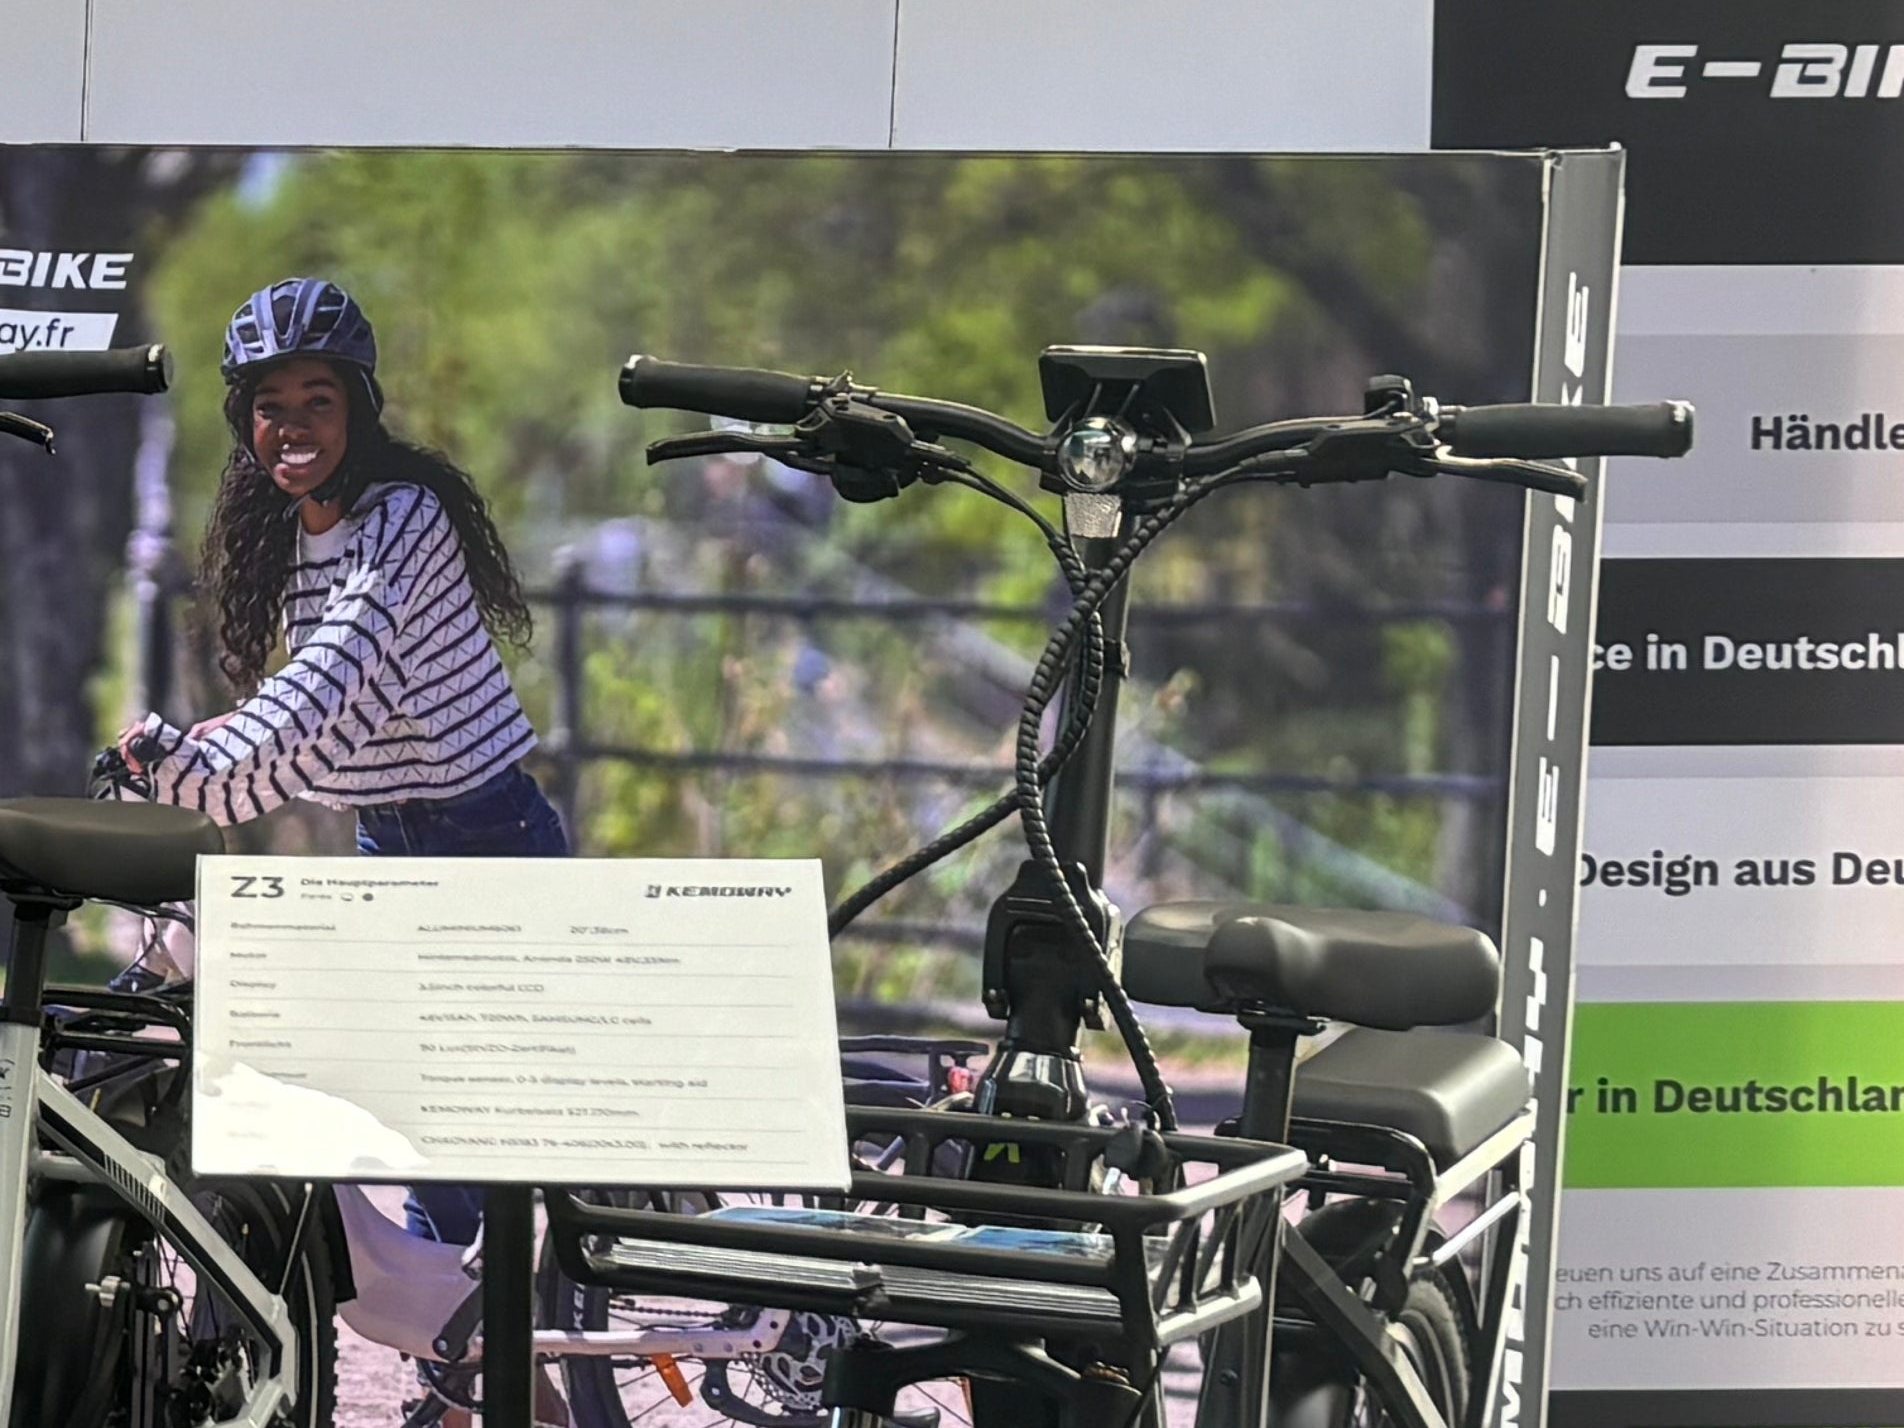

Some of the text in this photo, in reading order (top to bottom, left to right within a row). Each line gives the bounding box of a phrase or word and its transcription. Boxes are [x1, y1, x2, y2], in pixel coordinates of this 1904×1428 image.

[1646, 632, 1687, 670] in
[1734, 858, 1817, 886] aus
[230, 876, 439, 899] Z3 Die Hauptparameter
[666, 885, 792, 898] KEMOWAY
[1597, 1077, 1637, 1113] in
[1620, 1266, 1662, 1282] uns
[1668, 1261, 1706, 1282] auf
[1710, 1264, 1760, 1281] eine
[1588, 1290, 1693, 1311] effiziente
[1700, 1290, 1746, 1310] und
[1588, 1321, 1638, 1339] eine
[1644, 1318, 1858, 1339] Win-Win-Situation
[1865, 1321, 1891, 1337] zu
